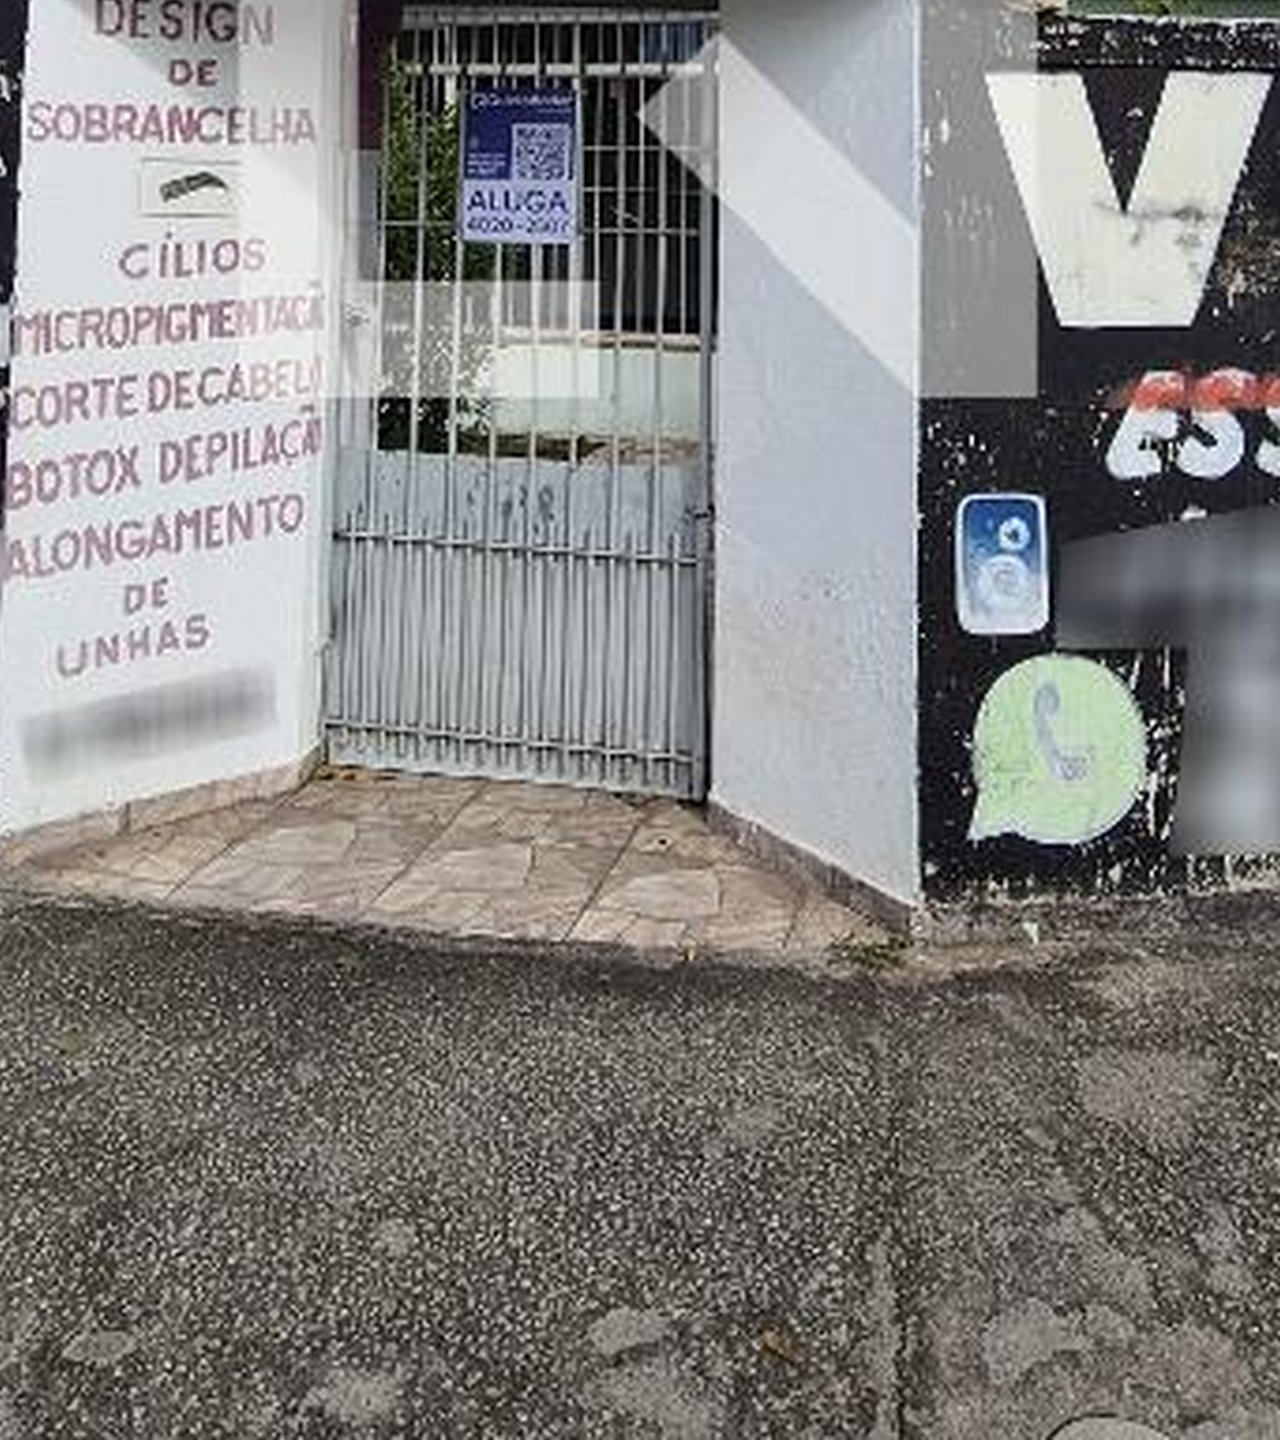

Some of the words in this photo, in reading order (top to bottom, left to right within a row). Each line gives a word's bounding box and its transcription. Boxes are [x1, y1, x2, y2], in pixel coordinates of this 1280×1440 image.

[168, 59, 220, 87] DE
[26, 102, 317, 145] SOBRANCELHA
[467, 190, 569, 214] ALUGA
[118, 232, 266, 280] CÍLIOS
[12, 374, 139, 431] CORTE
[148, 370, 194, 413] DE
[7, 445, 141, 509] BOTOX
[7, 494, 304, 578] ALONGAMENTO
[124, 578, 169, 615] DE
[57, 614, 210, 677] UNHAS
